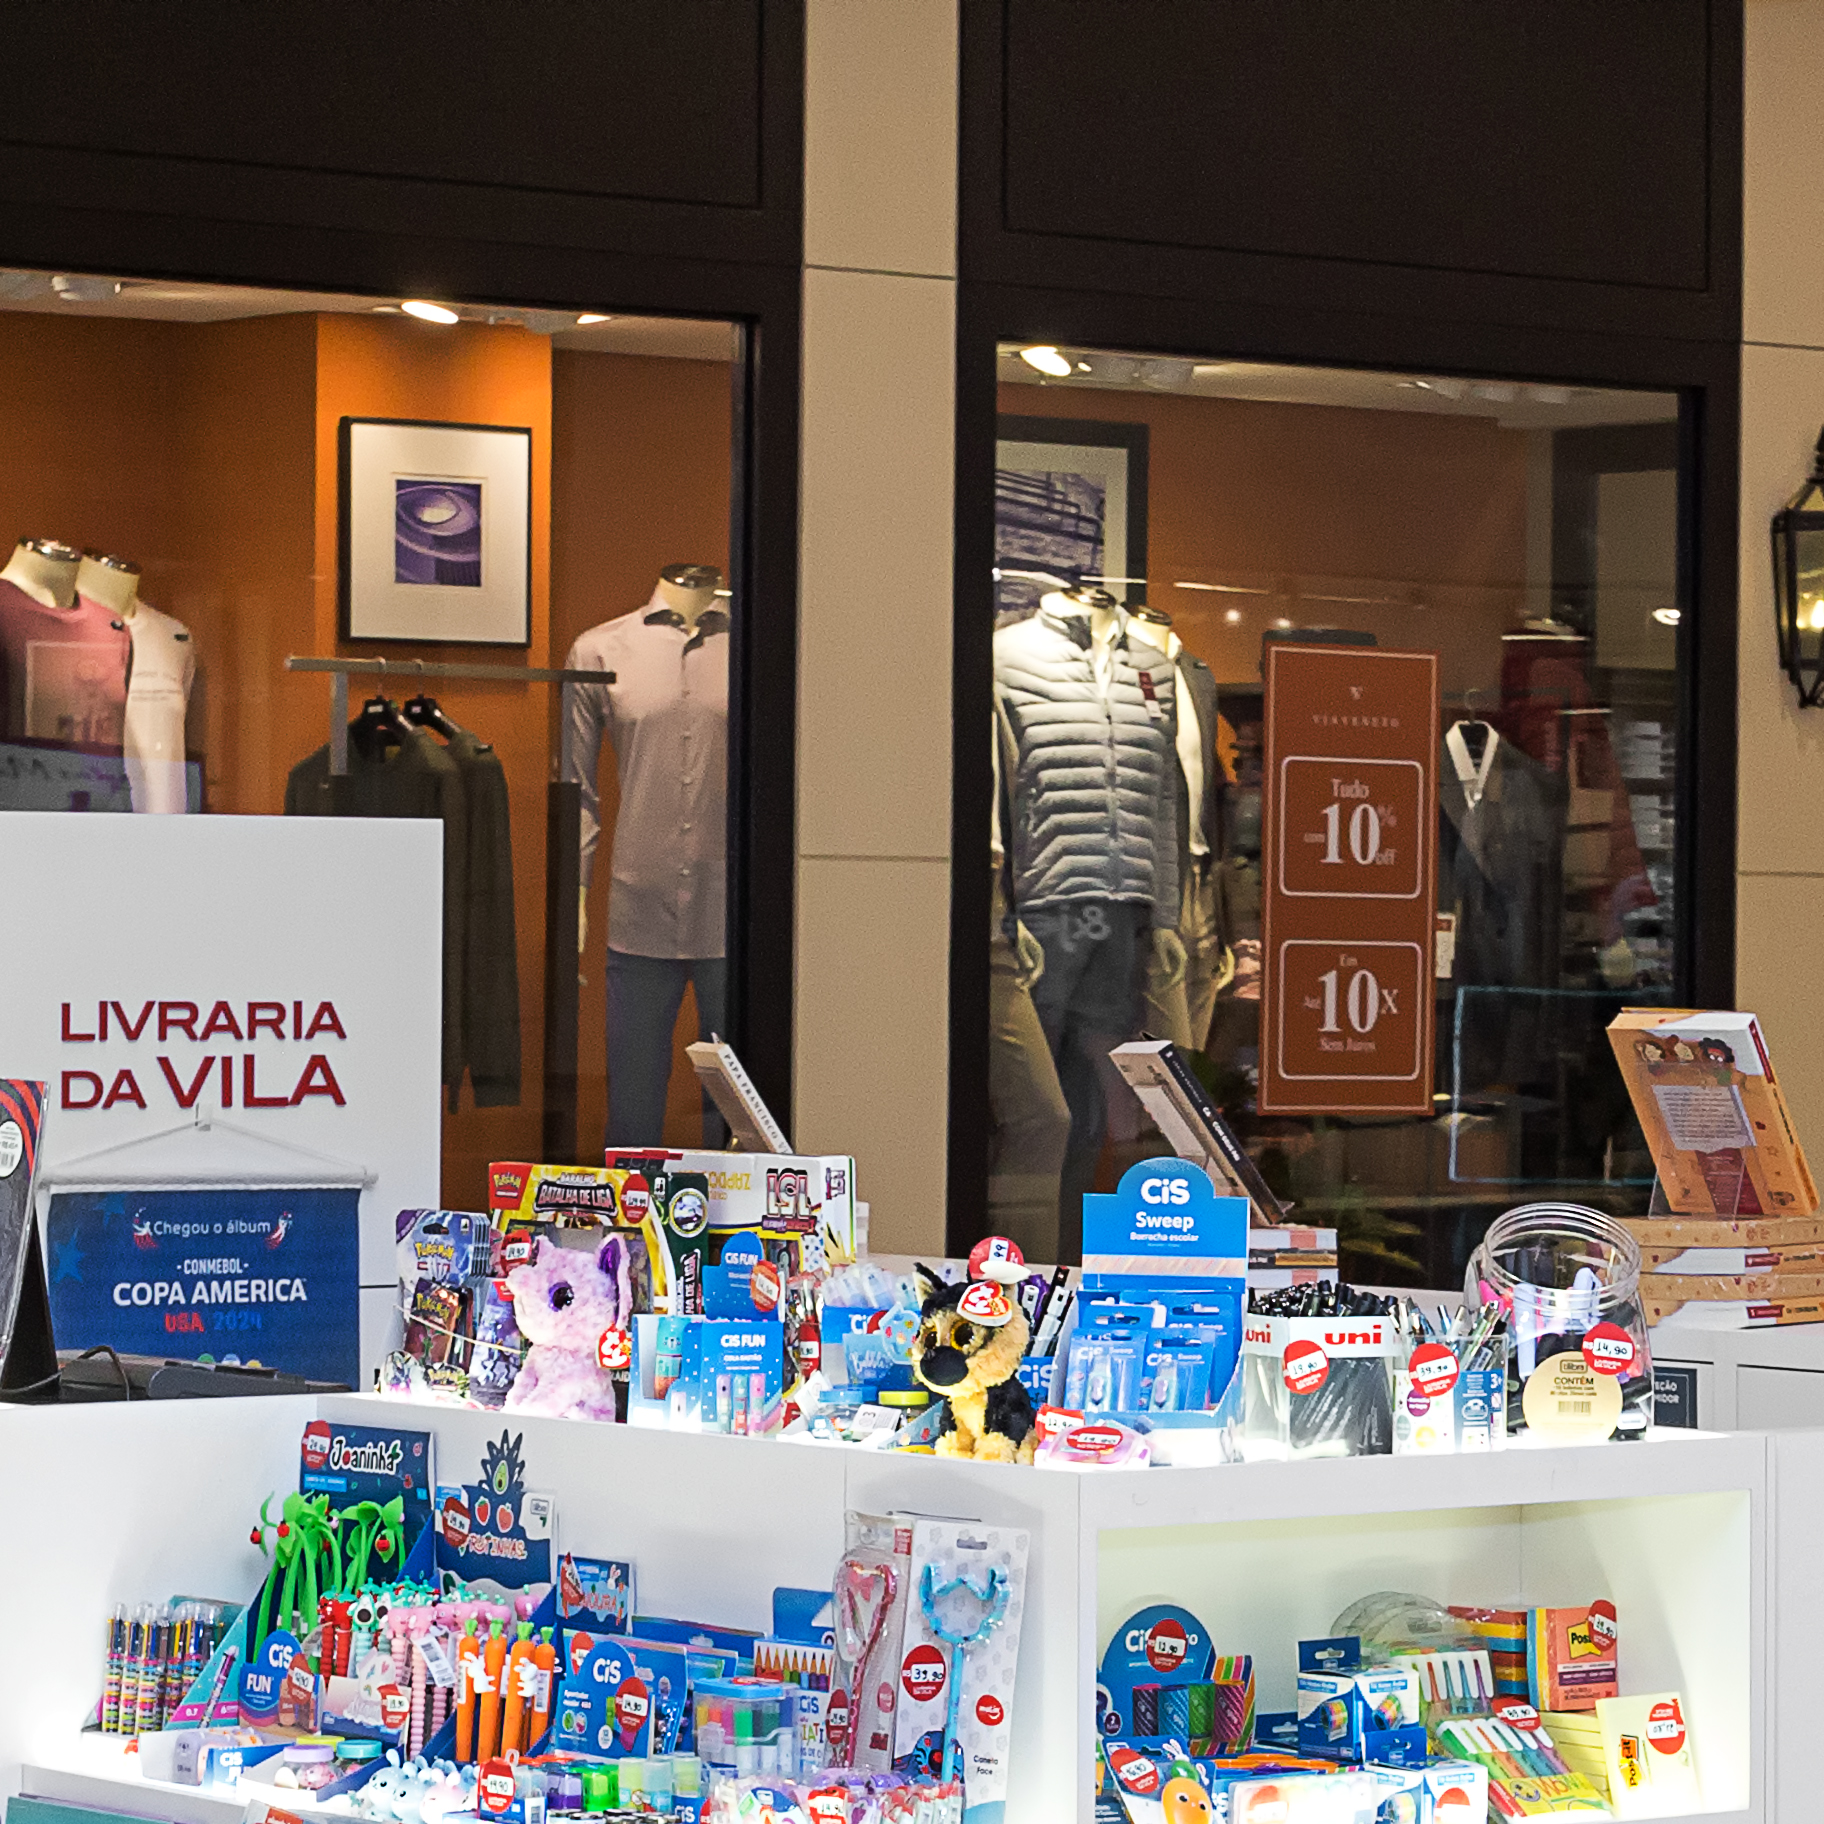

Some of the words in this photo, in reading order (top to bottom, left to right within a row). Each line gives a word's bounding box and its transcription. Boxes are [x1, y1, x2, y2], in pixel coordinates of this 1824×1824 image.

[1331, 778, 1369, 800] Tudo
[61, 1000, 347, 1041] LIVRARIA
[61, 1069, 147, 1109] DA
[156, 1054, 347, 1109] VILA
[724, 1053, 743, 1085] PAPA
[741, 1084, 780, 1141] FRANCISCO
[539, 1184, 578, 1207] BATALHA
[579, 1187, 592, 1207] DE
[592, 1187, 616, 1210] LIGA
[153, 1219, 210, 1238] Chegou
[212, 1223, 222, 1235] o
[226, 1219, 271, 1236] álbum
[1135, 1211, 1194, 1232] Sweep
[1169, 1233, 1199, 1242] escolar
[113, 1281, 186, 1306] COPA
[191, 1279, 307, 1305] AMERICA
[742, 1333, 766, 1348] FUN
[1245, 1325, 1271, 1345] uni
[1324, 1324, 1382, 1345] uni
[330, 1435, 404, 1475] Joaninha
[246, 1672, 273, 1693] FUN
